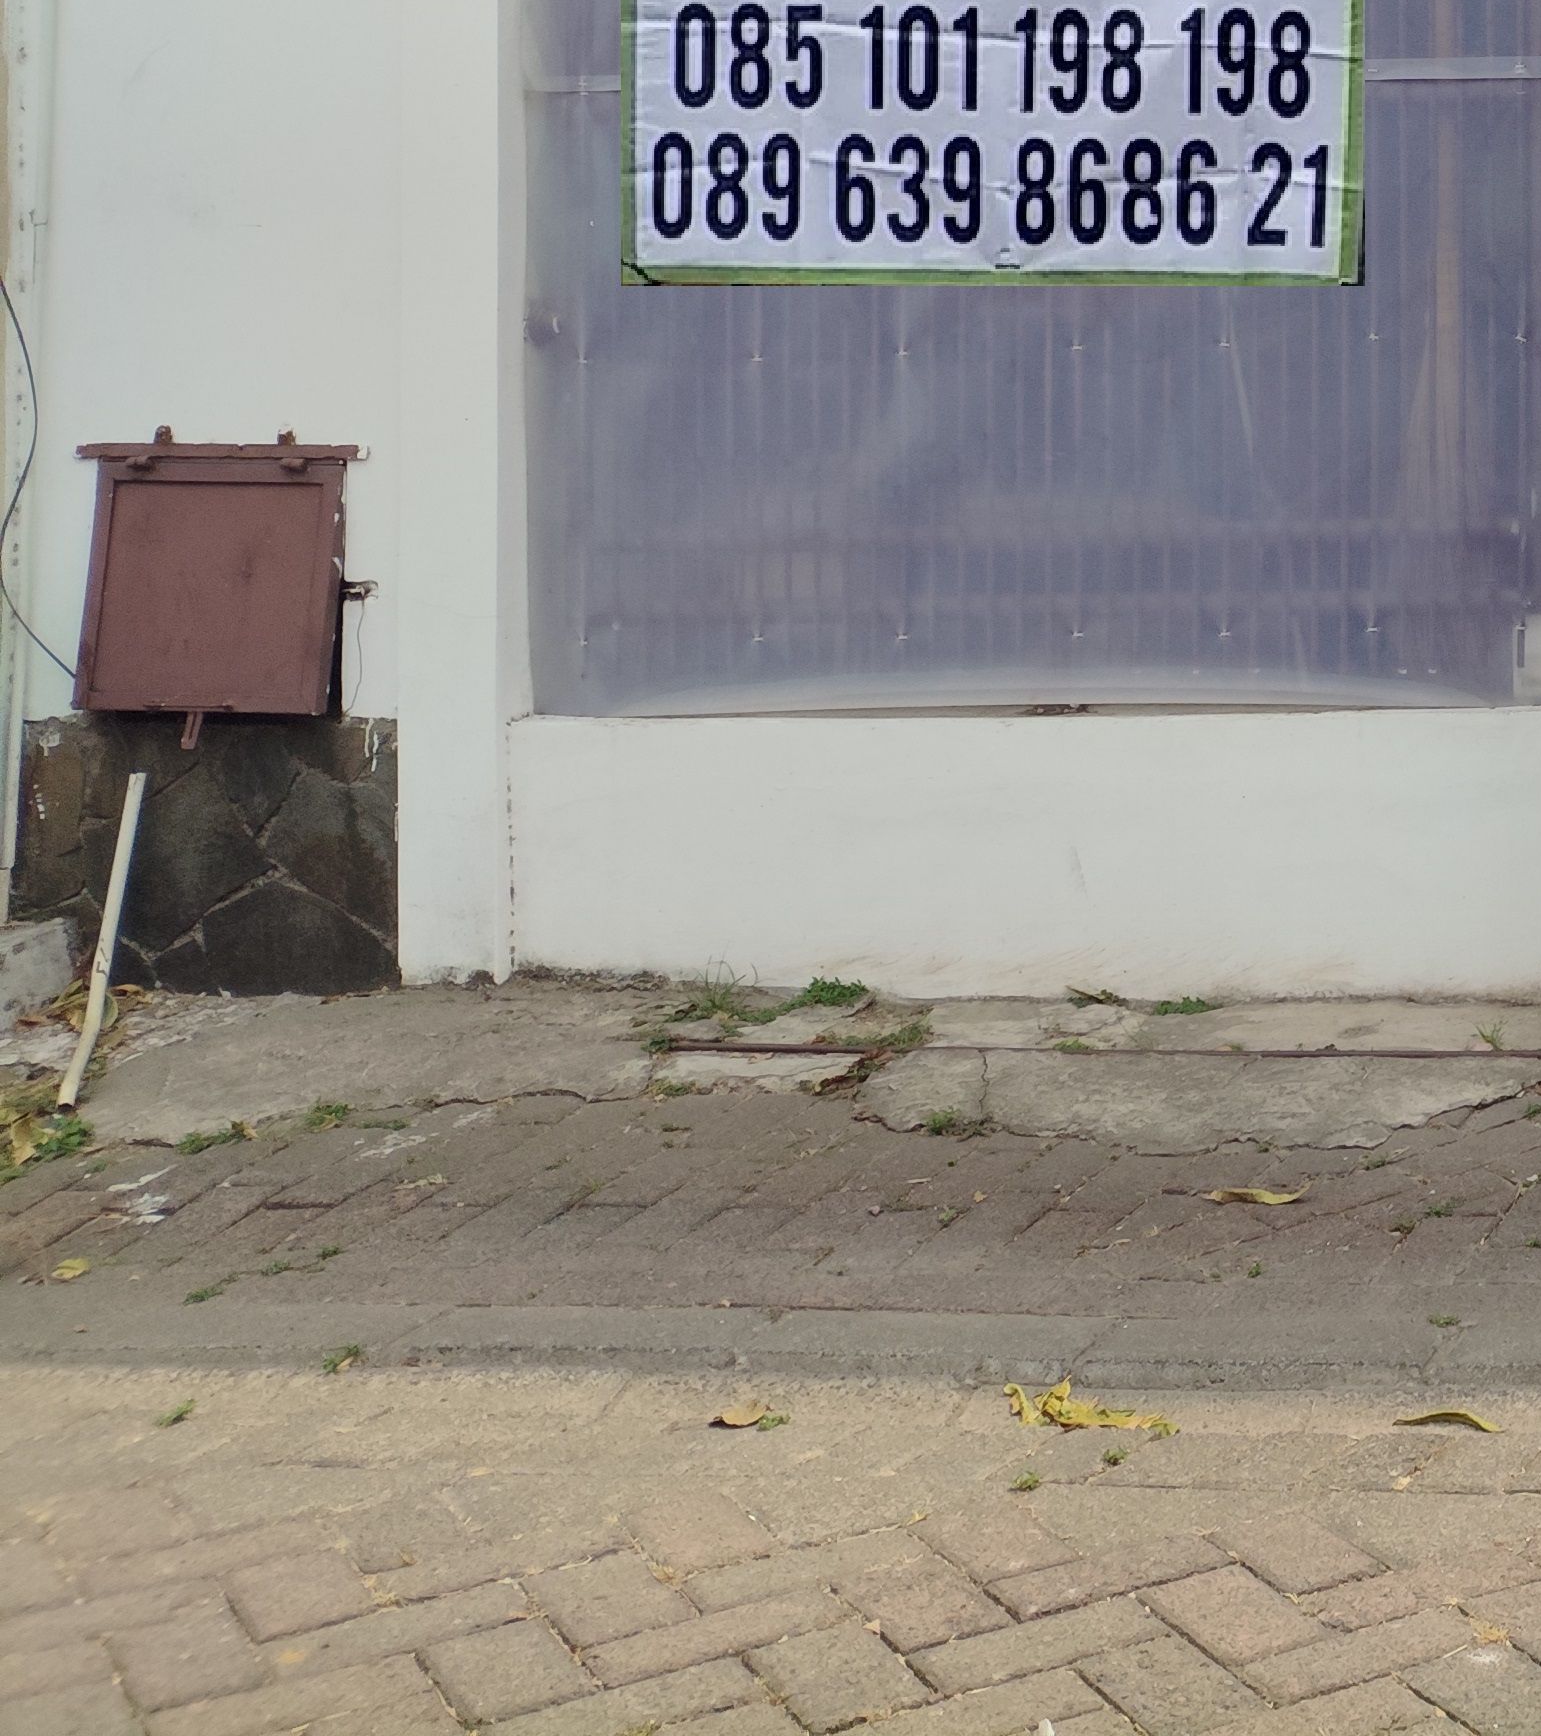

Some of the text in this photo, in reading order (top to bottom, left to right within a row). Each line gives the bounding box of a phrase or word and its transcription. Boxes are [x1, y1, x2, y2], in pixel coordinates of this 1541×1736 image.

[673, 3, 1311, 118] 085 101 198 198
[652, 132, 1330, 248] 089 639 8686 21
